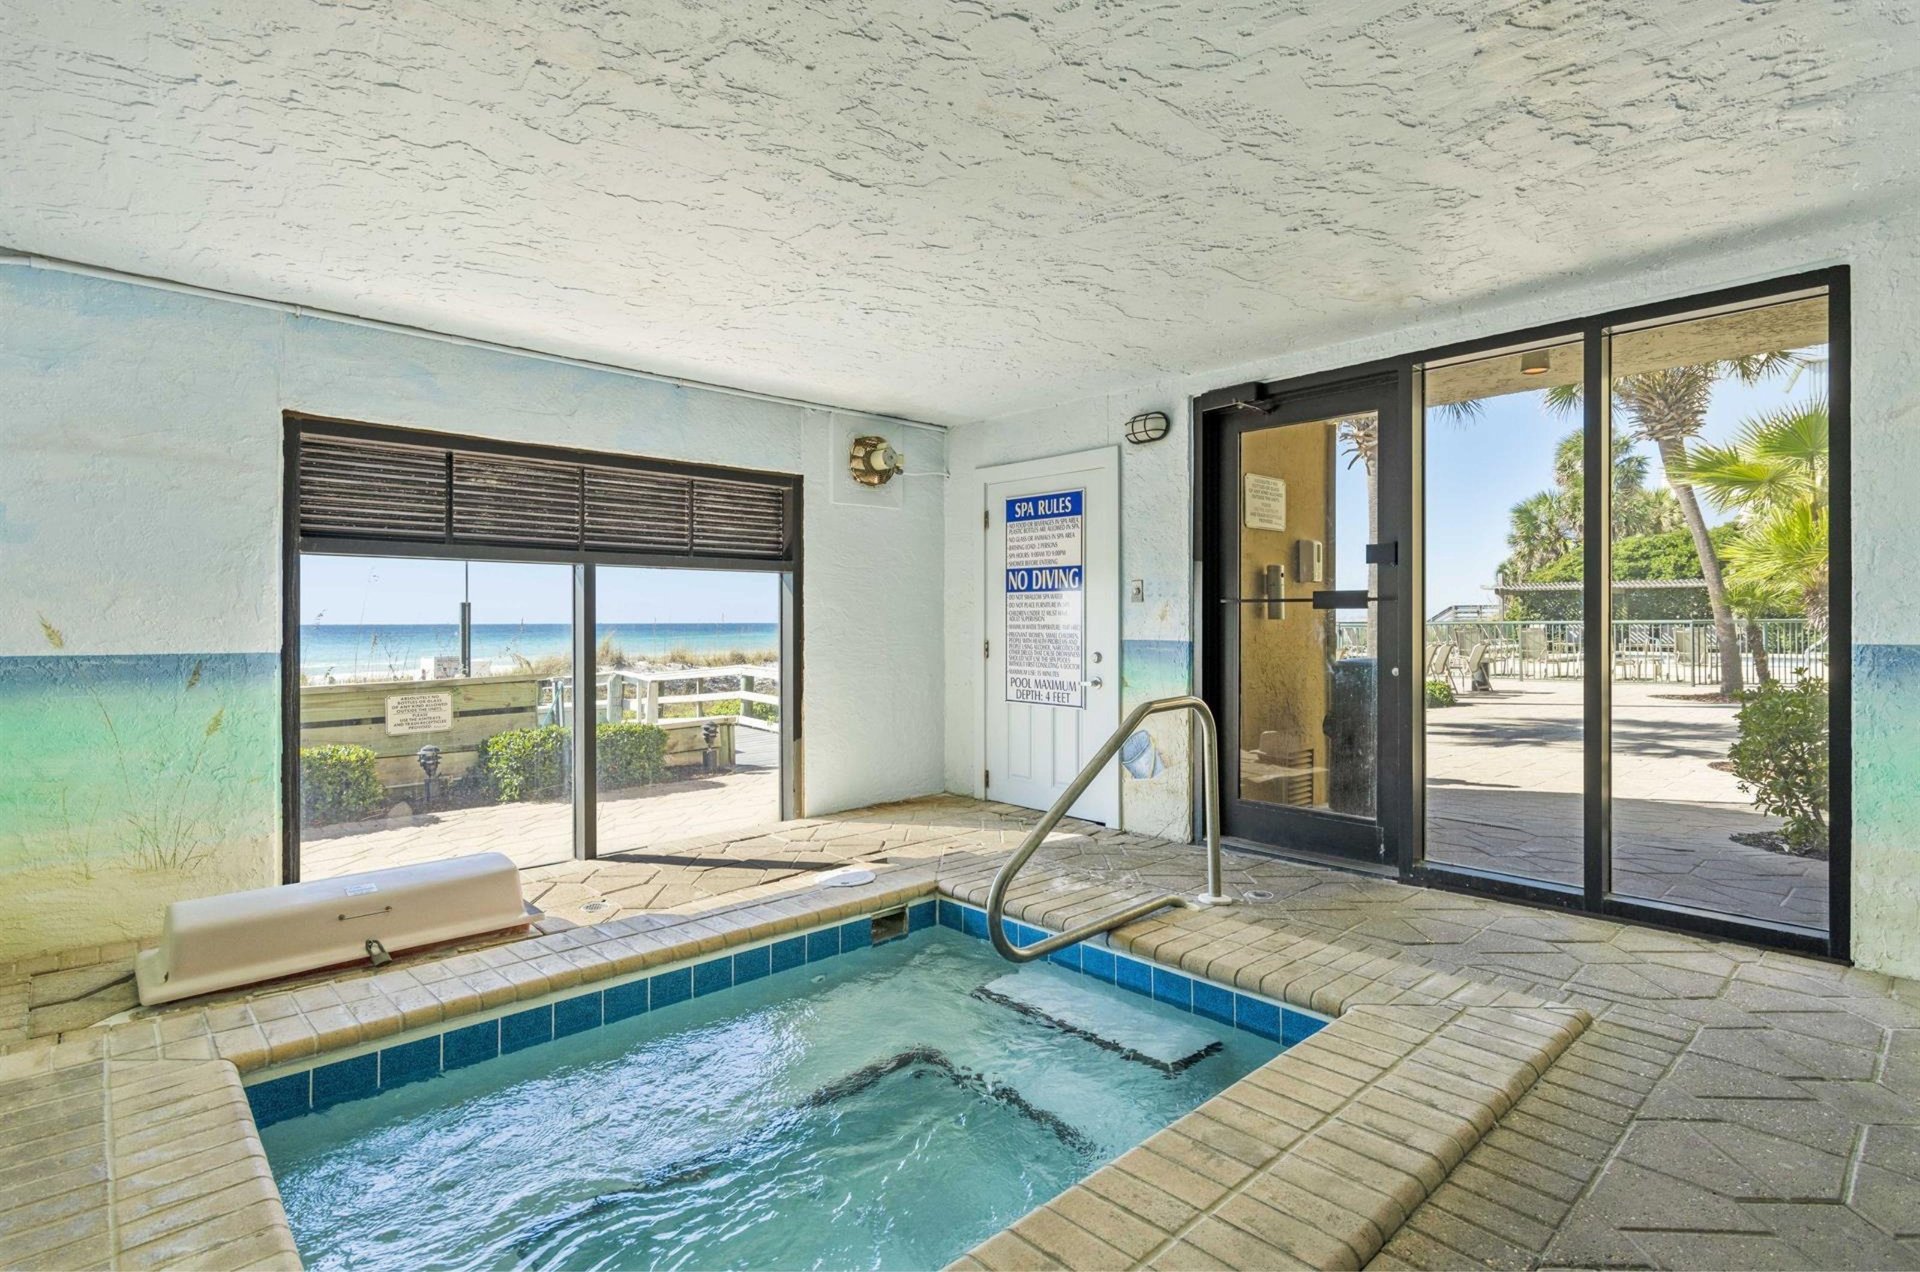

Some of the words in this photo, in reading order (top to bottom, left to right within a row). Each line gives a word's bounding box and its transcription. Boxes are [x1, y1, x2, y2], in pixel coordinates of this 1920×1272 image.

[1015, 502, 1034, 518] SPA
[1038, 497, 1071, 515] RULES
[1009, 571, 1028, 590] NO
[1032, 568, 1078, 589] DIVING
[1011, 677, 1031, 688] POOL
[1035, 679, 1076, 691] MAXIMUM
[1016, 689, 1043, 701] DEPTH:
[1045, 692, 1050, 701] 4
[1053, 692, 1070, 703] FEET
